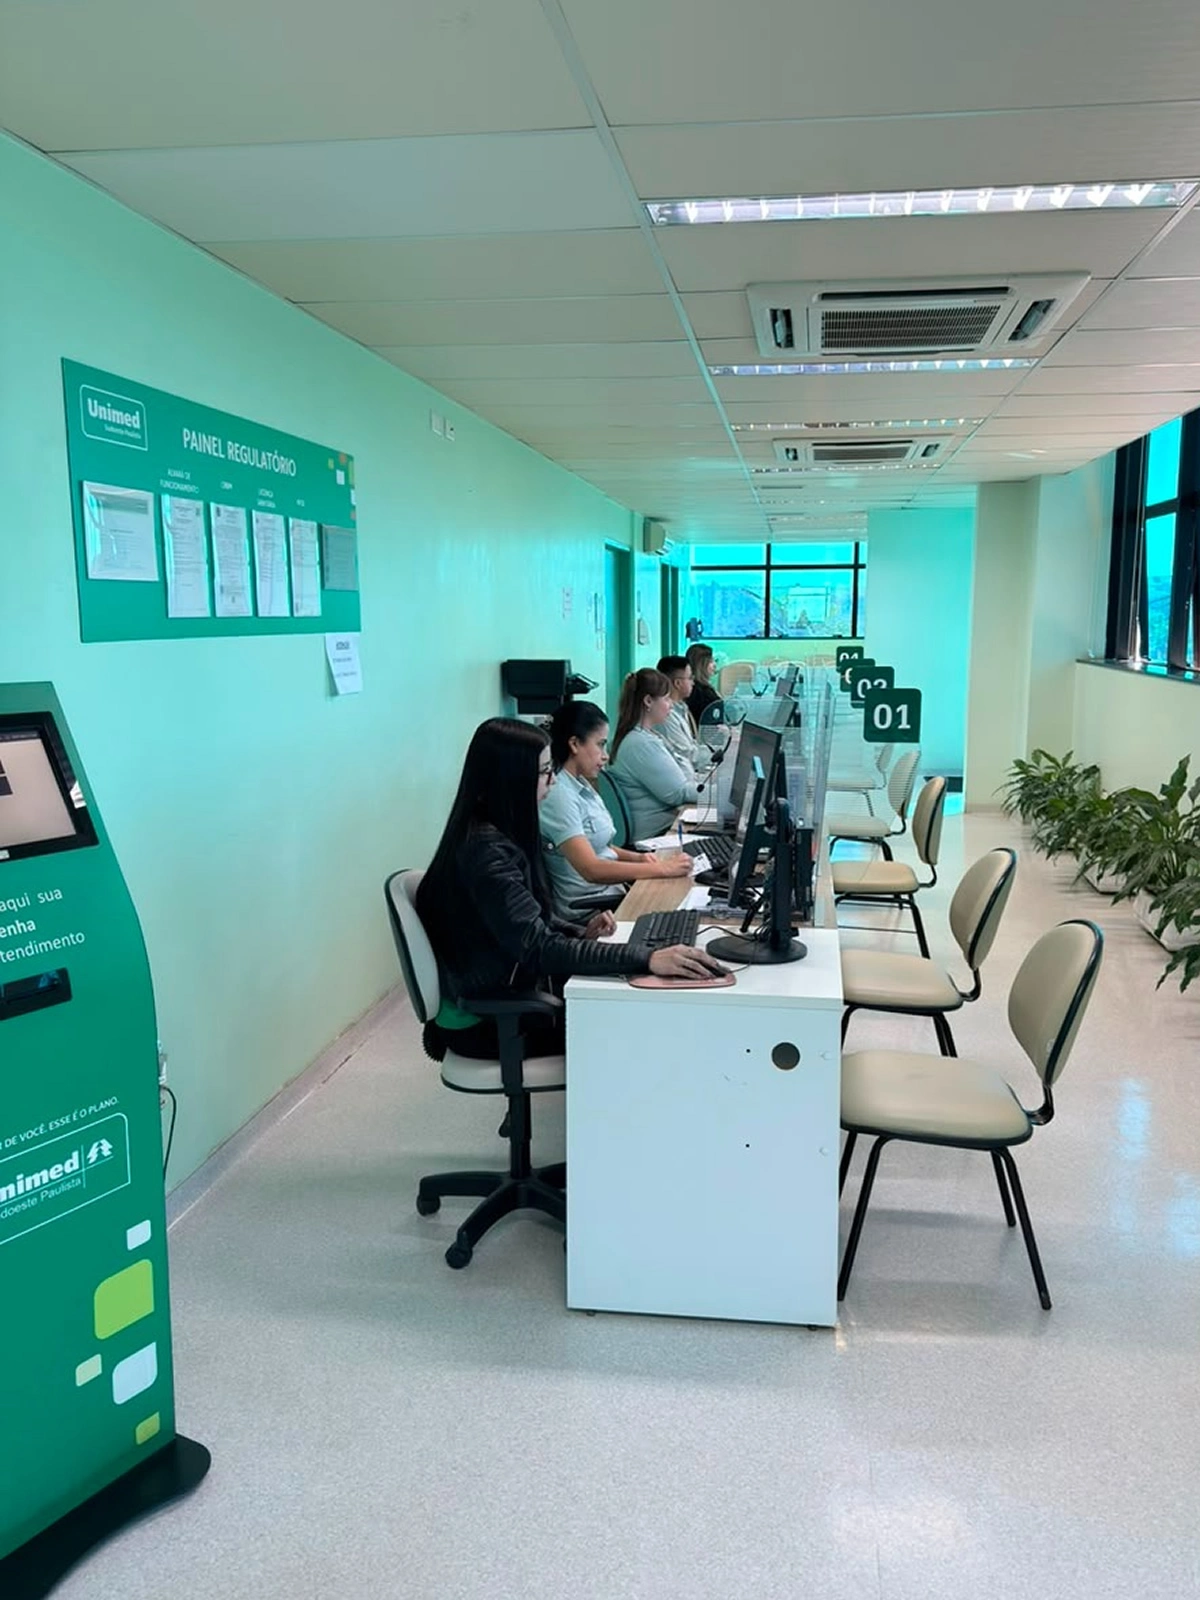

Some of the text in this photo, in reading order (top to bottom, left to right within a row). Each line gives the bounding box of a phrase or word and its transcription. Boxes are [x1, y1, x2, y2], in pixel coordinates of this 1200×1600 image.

[87, 398, 140, 429] Unimed
[183, 428, 297, 477] PAINEL REGULATÓRIO
[873, 704, 911, 729] 01
[0, 889, 63, 912] aqui sua
[4, 1136, 17, 1148] DE
[48, 1114, 71, 1131] ESSE
[72, 1109, 79, 1121] É
[79, 1108, 87, 1118] O
[0, 1177, 82, 1219] doeste Paulista
